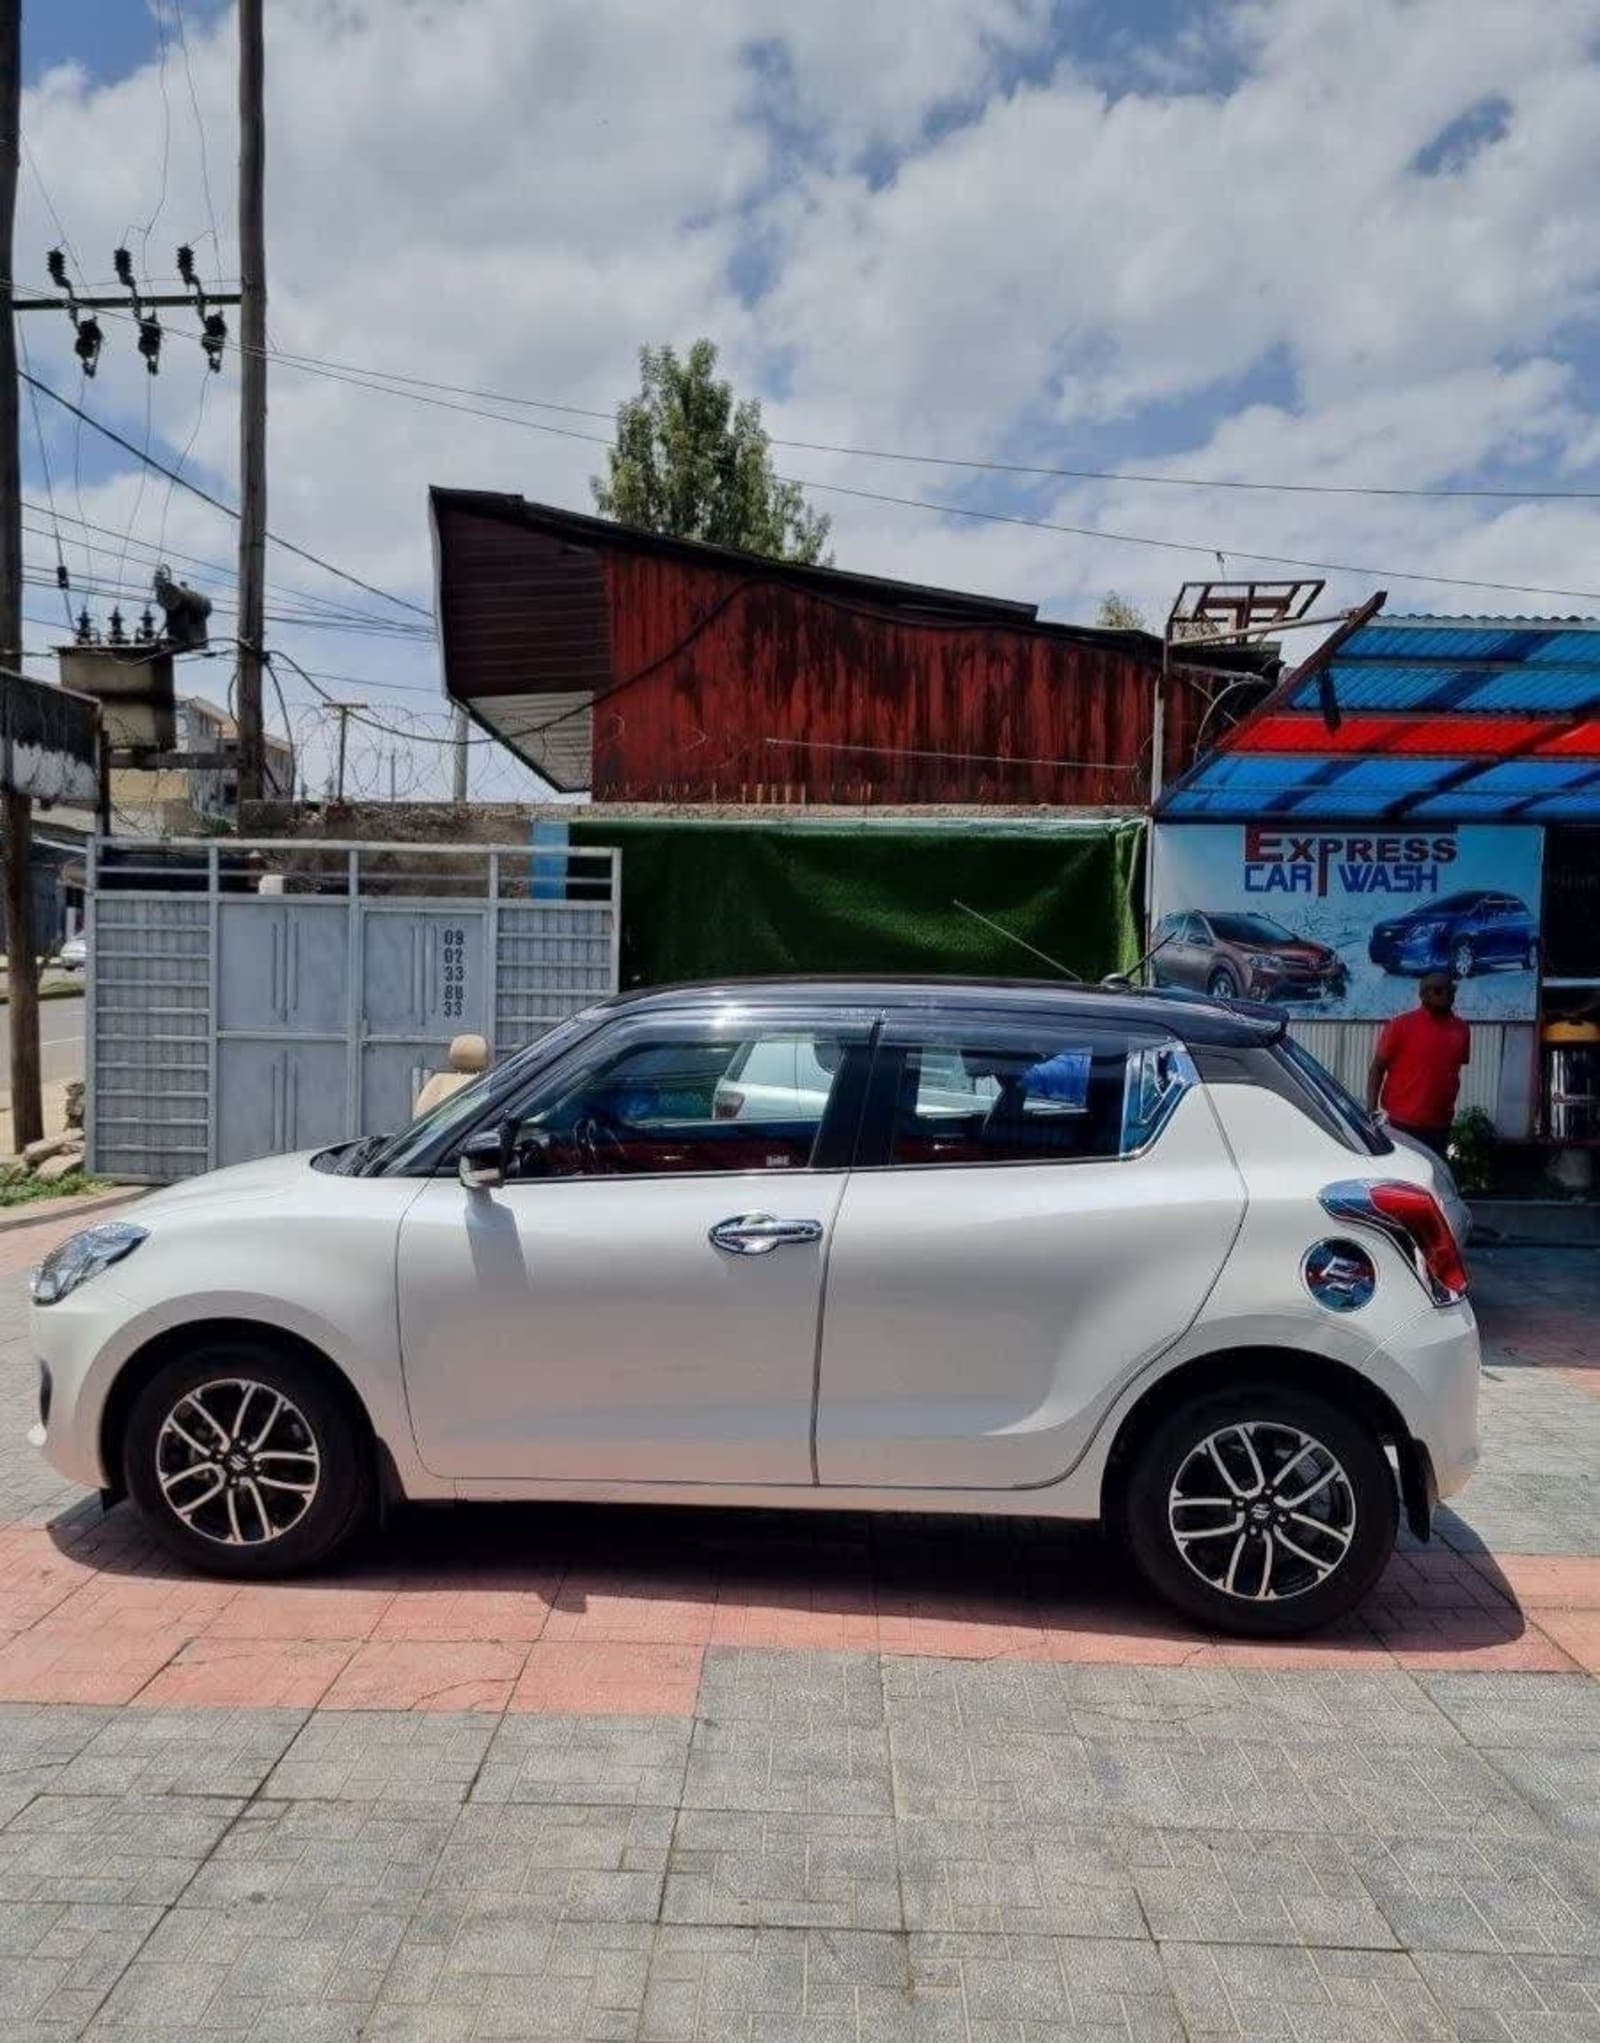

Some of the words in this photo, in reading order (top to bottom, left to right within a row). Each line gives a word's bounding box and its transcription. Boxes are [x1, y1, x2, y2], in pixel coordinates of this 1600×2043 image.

[1245, 864, 1312, 893] CAR
[1338, 864, 1438, 893] WASH
[444, 1001, 462, 1017] 33
